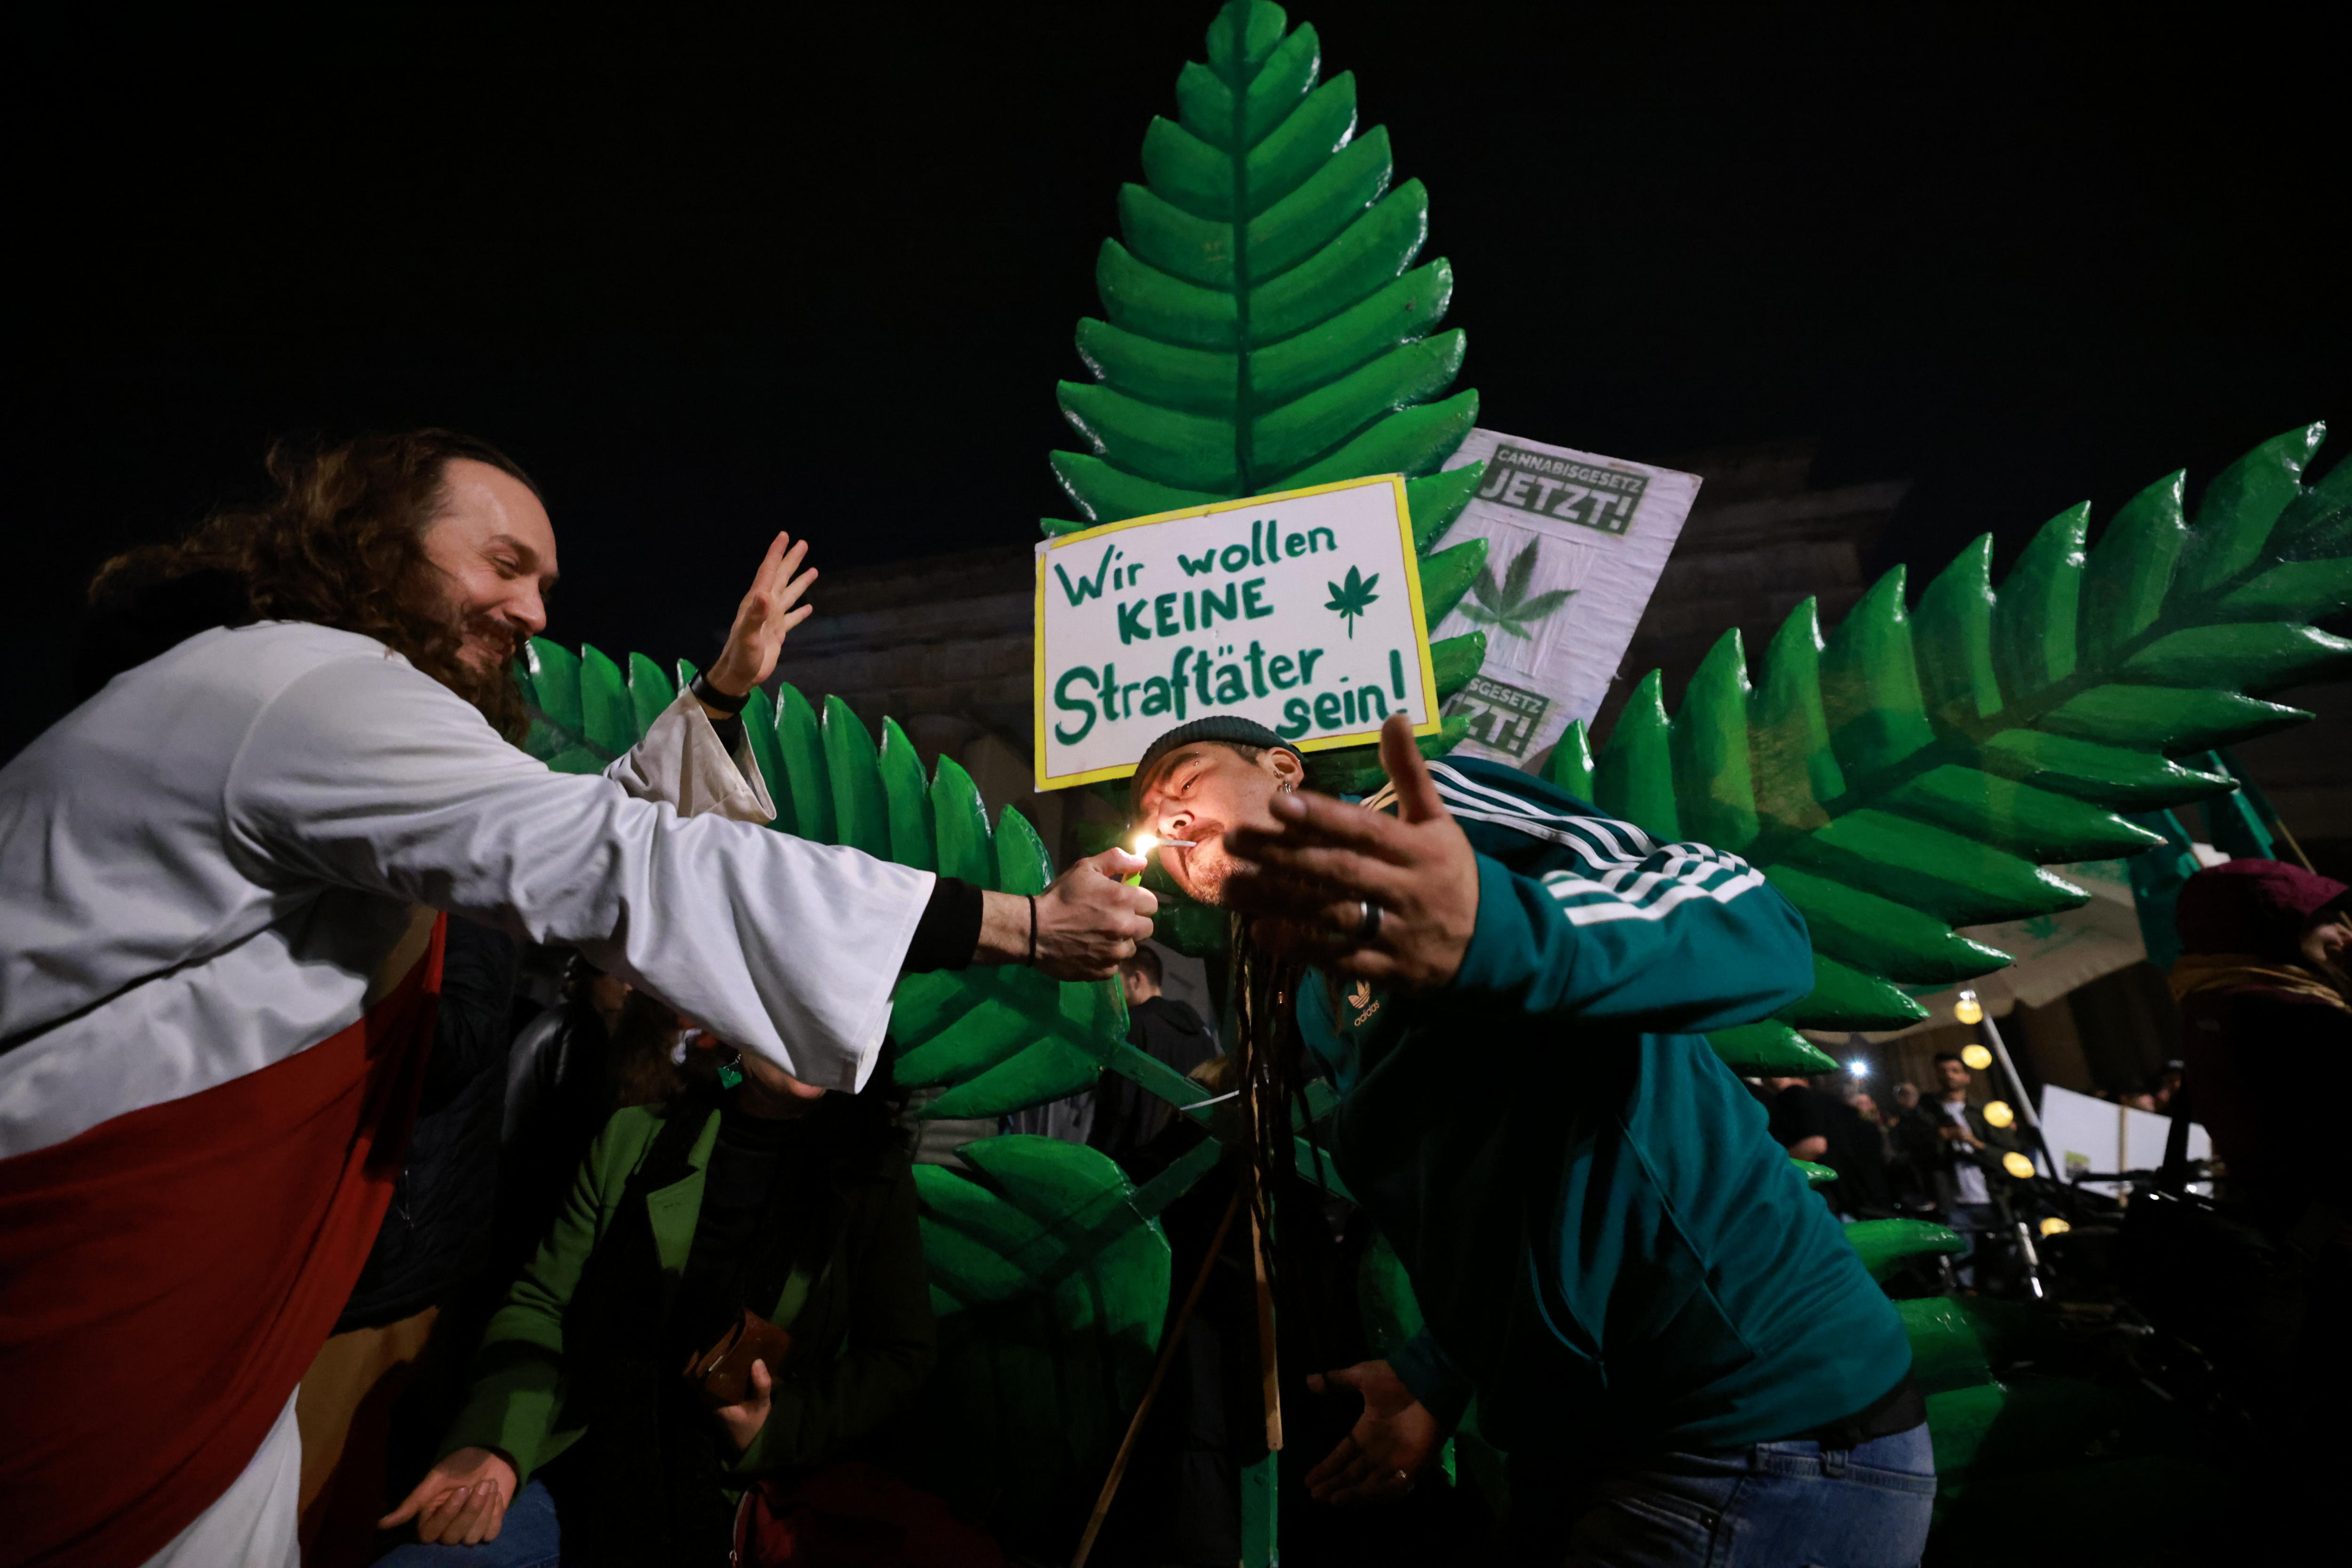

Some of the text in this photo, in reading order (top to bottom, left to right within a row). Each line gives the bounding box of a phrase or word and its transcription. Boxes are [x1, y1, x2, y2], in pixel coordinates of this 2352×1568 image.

[1481, 468, 1632, 530] JETZT!
[1497, 450, 1644, 493] CANNABISGESETZ
[1054, 520, 1337, 607] Wir wollen
[1118, 577, 1274, 645] KEINE
[1054, 641, 1324, 746] Straftäter
[1276, 649, 1408, 740] sein!
[1468, 677, 1543, 714] SGESETZ
[1354, 1000, 1380, 1026] adidas
